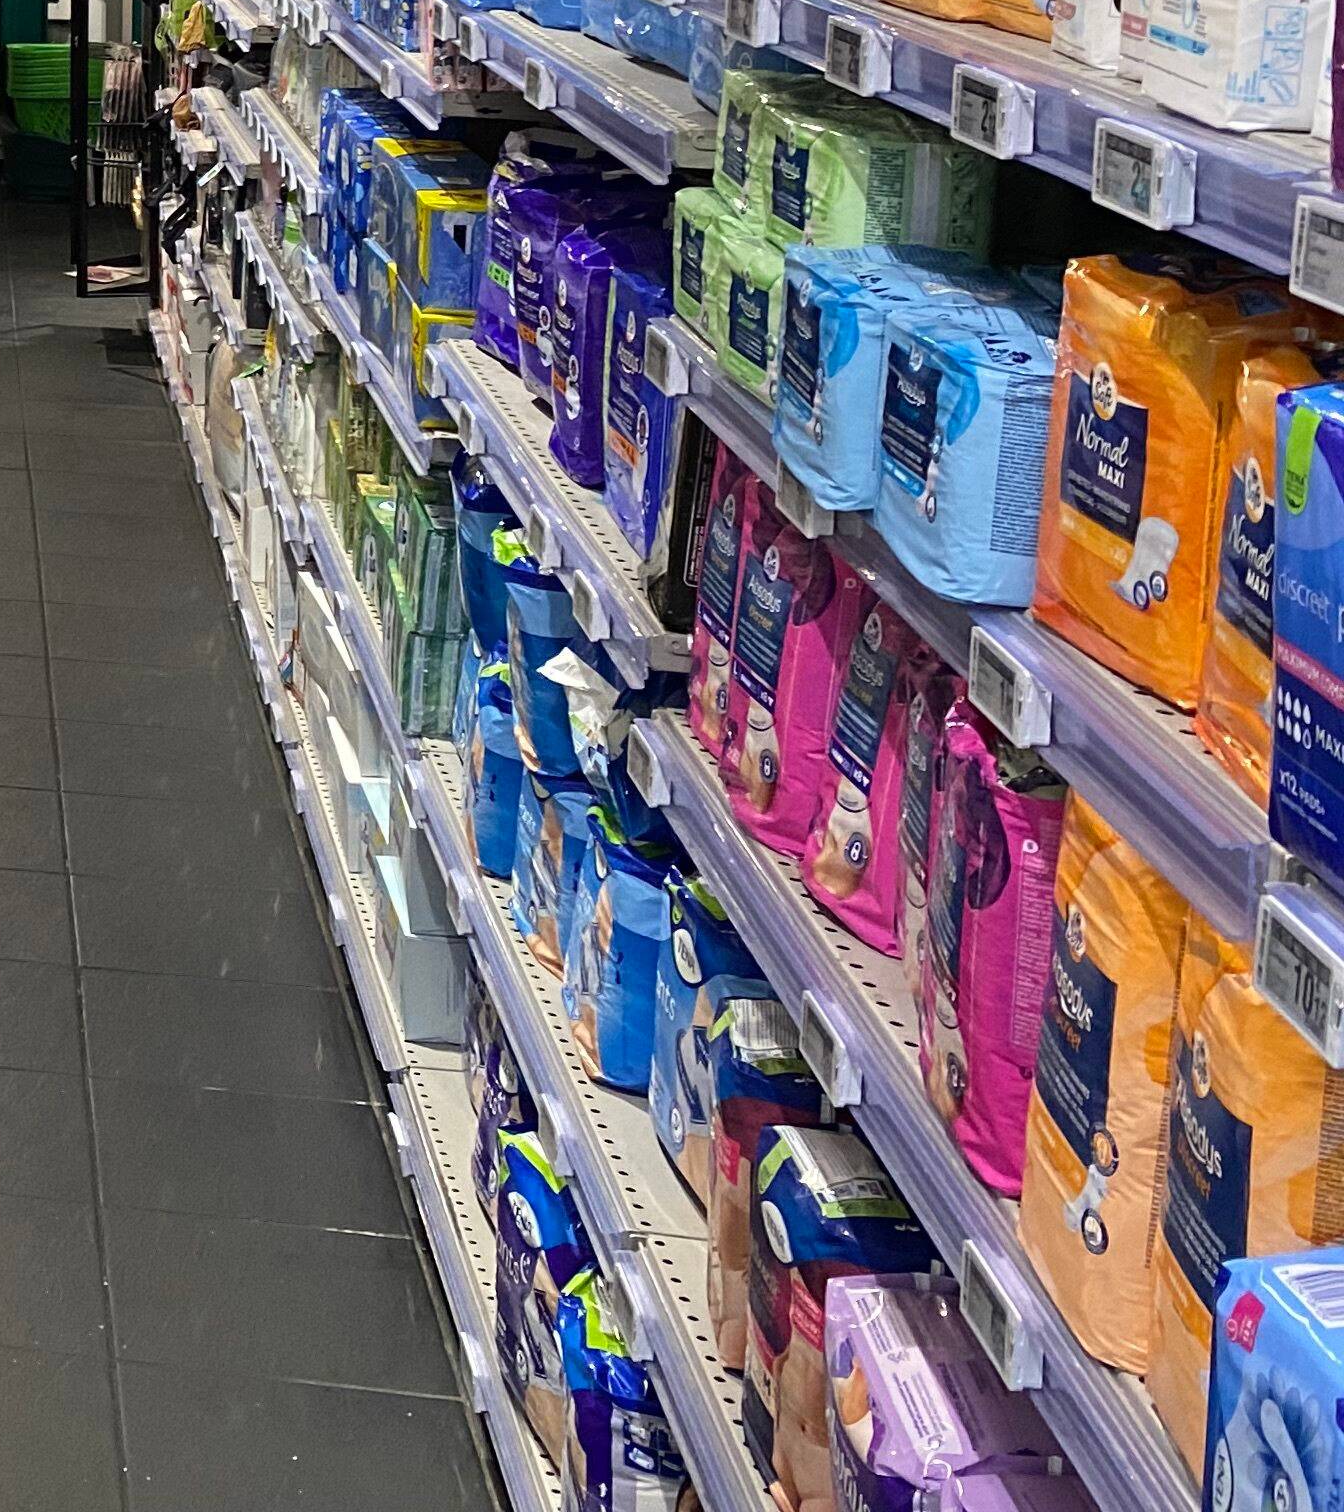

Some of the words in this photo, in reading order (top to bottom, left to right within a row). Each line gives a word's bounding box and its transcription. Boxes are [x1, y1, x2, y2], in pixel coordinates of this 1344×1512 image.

[1076, 414, 1129, 469] Normal
[1098, 460, 1125, 489] MAXI
[1228, 515, 1273, 577] Normal
[1246, 567, 1270, 601] MAXI
[1278, 569, 1331, 625] discreet
